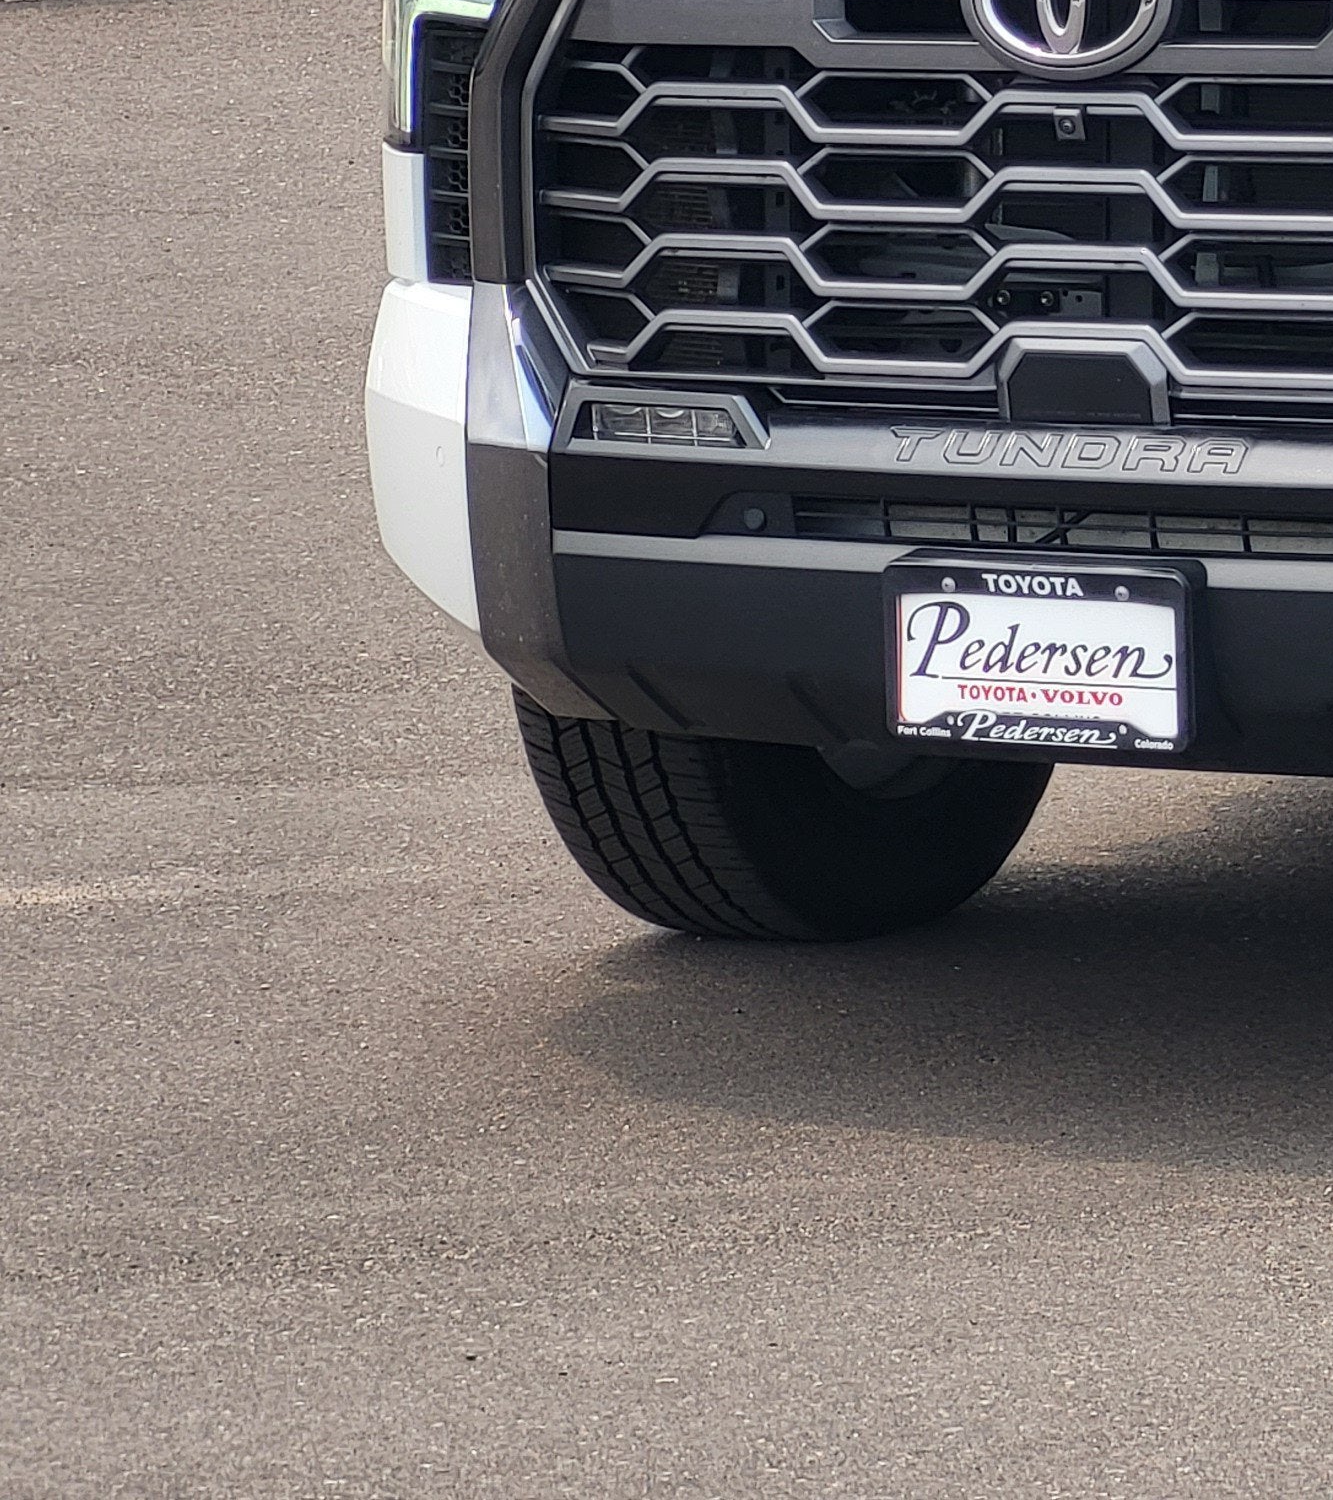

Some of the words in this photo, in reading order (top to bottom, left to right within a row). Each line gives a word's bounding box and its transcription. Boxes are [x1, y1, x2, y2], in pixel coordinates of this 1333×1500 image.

[889, 426, 1250, 475] TUNDRA
[981, 573, 1084, 597] TOYOTA
[906, 600, 1174, 679] Pedersen
[957, 684, 1028, 703] TOYOTA
[1040, 688, 1124, 706] VOLVO
[897, 725, 918, 736] Fort
[919, 726, 951, 738] Collins
[956, 708, 1117, 744] Pedersen
